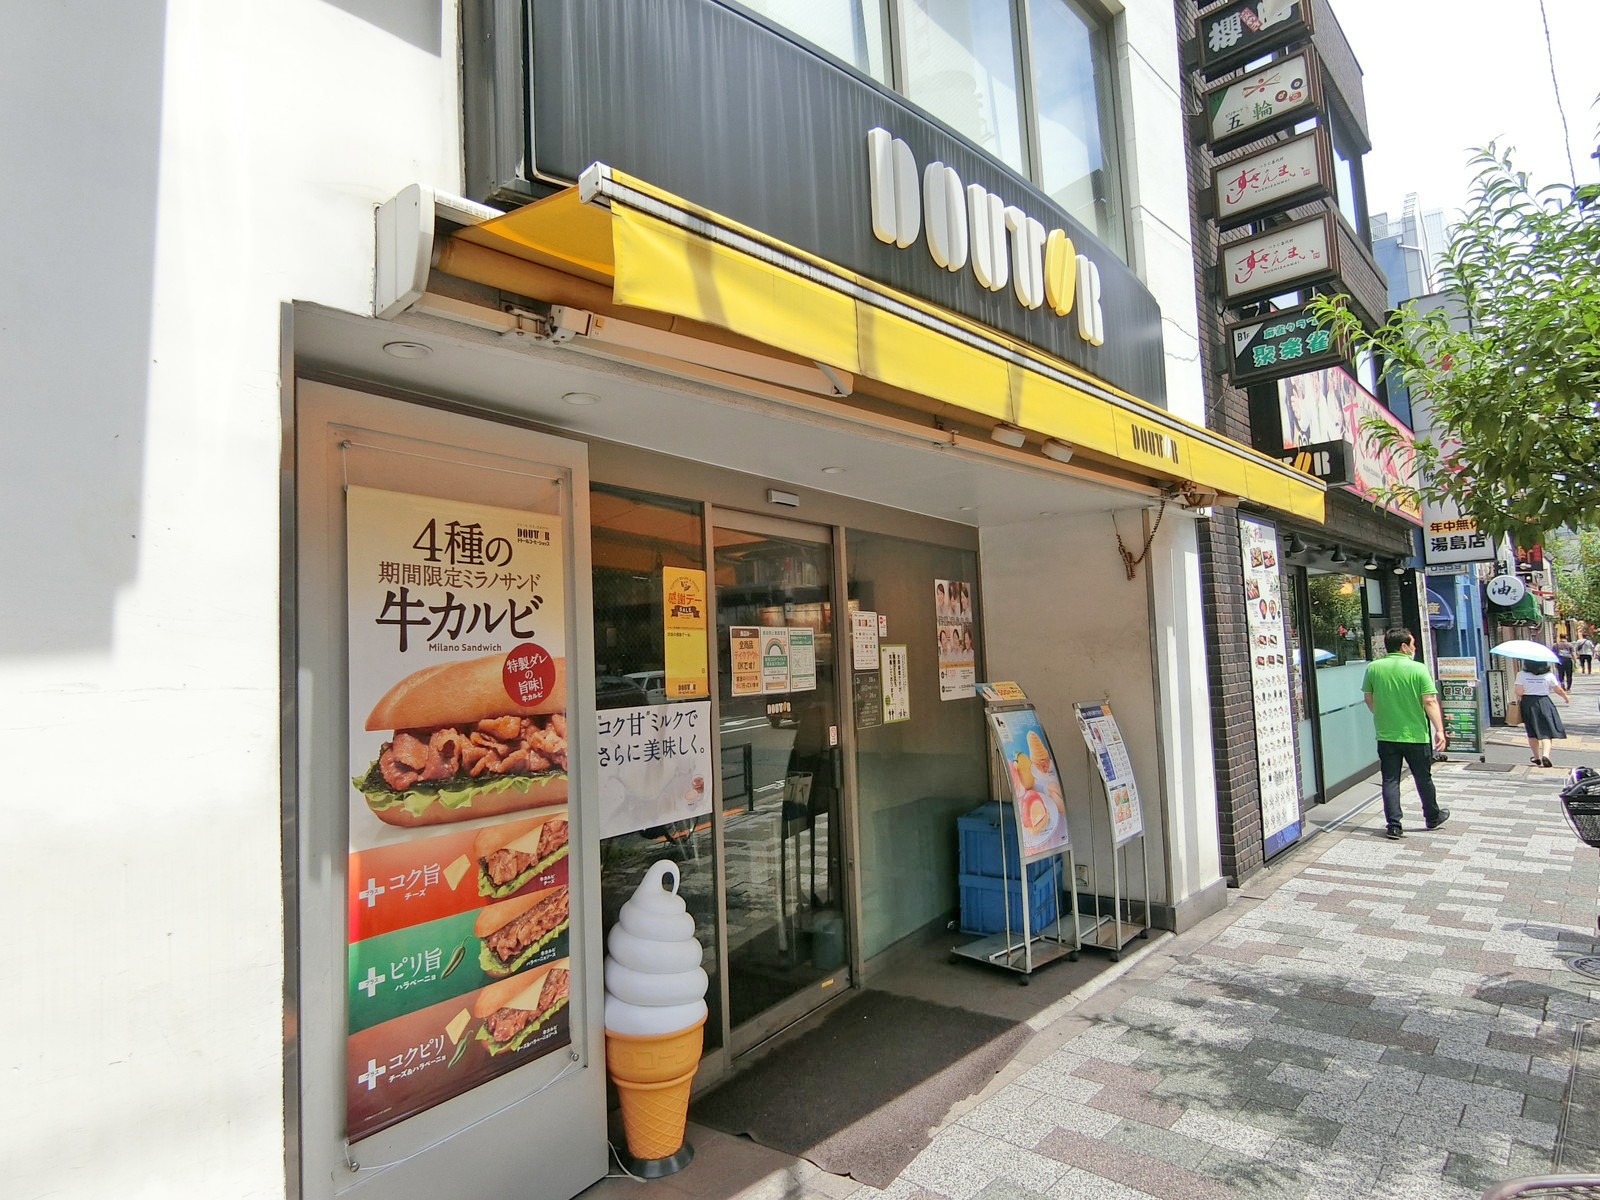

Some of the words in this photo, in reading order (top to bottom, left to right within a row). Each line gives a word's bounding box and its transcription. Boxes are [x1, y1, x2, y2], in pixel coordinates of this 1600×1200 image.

[867, 126, 1104, 346] DOUTOR
[1131, 423, 1180, 464] DOUTOR
[412, 518, 513, 567] 4種の
[1430, 534, 1486, 552] 湯島店
[378, 561, 541, 593] 期間限定ミラノサンド
[667, 592, 703, 605] 感謝デー
[375, 586, 544, 653] 牛カルビ
[428, 643, 460, 652] Milano
[461, 643, 502, 652] Sandwich
[506, 653, 549, 674] 特製ダレ
[524, 669, 534, 680] の
[766, 701, 791, 715] DOUTOR
[597, 734, 705, 767] さらに美味しく。
[389, 863, 441, 890] コク旨
[404, 888, 426, 900] チーズ
[390, 947, 443, 979] ピリ旨
[395, 973, 437, 991] ハラペーニョ
[389, 1034, 445, 1070] コクピリ
